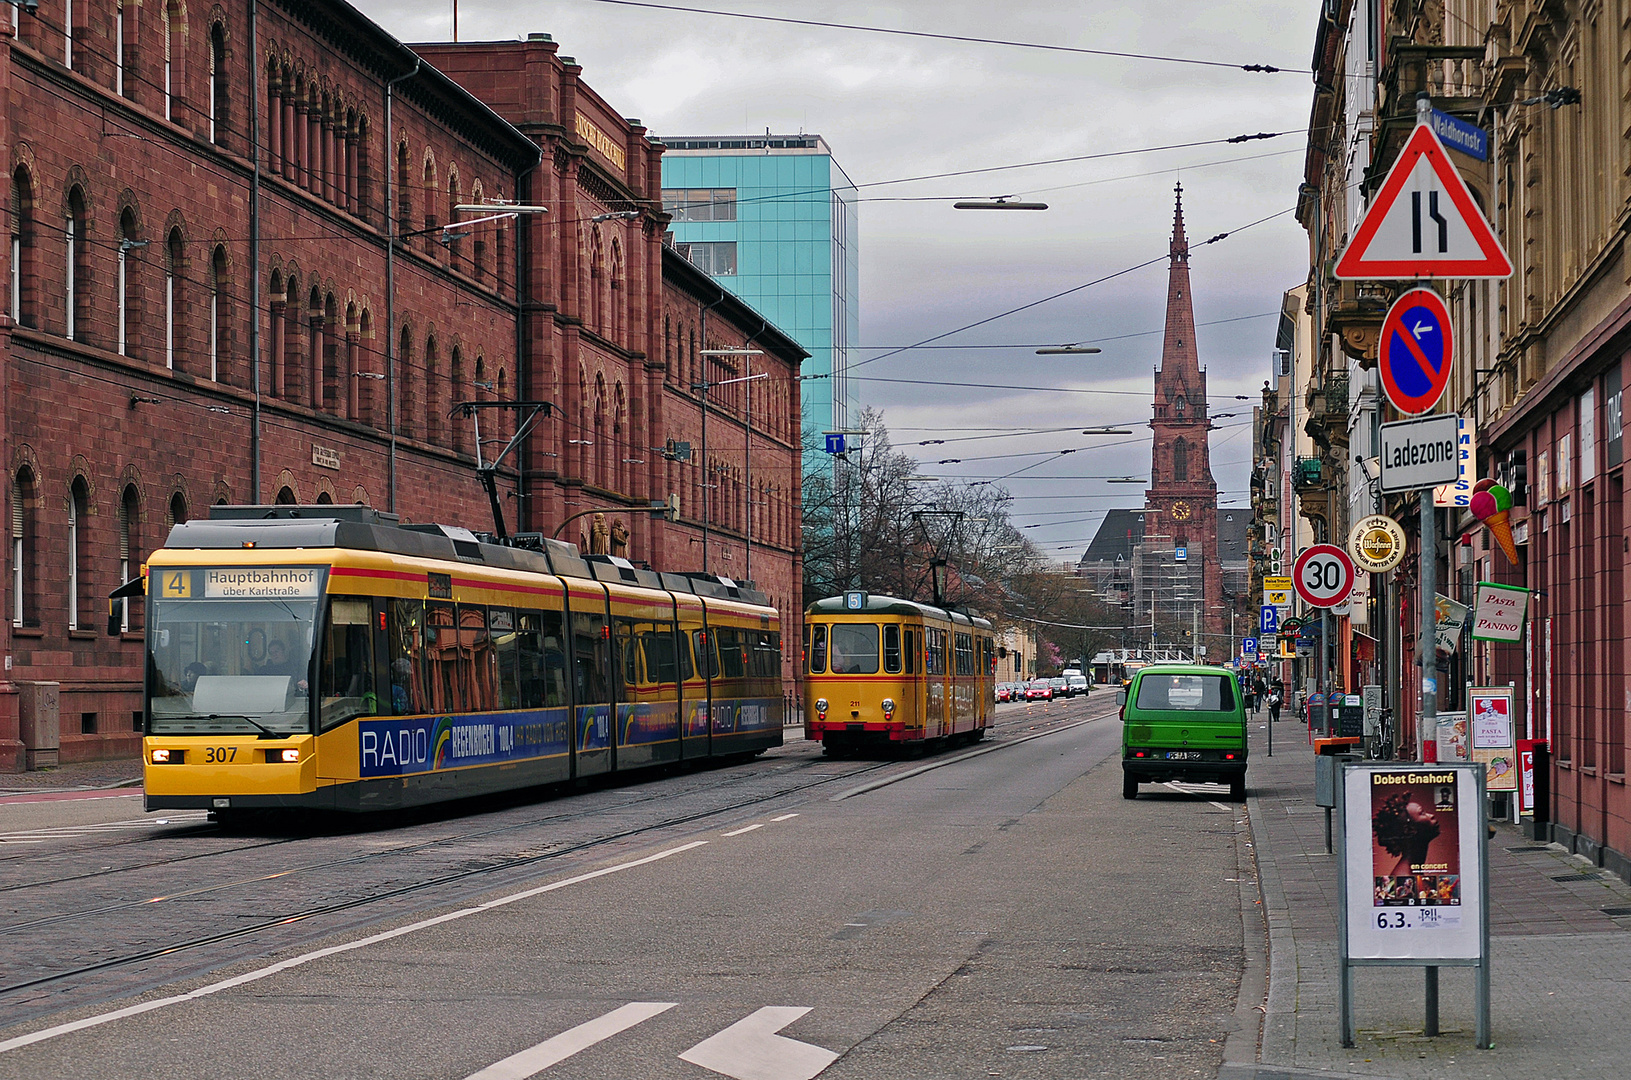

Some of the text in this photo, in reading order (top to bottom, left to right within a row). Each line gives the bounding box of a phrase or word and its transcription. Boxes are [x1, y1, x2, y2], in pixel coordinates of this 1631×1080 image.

[1433, 113, 1483, 153] Waldhornstr.
[829, 437, 840, 451] T
[1384, 438, 1453, 469] Ladezone
[168, 569, 314, 594] 4 Hauptbahnhof
[1306, 560, 1340, 590] 30
[222, 586, 300, 596] über Karlstraße
[1351, 588, 1366, 598] Copy
[849, 593, 859, 608] 5
[1485, 594, 1516, 607] PASTA
[1263, 608, 1274, 630] P
[1477, 619, 1518, 632] PANINO
[1245, 639, 1255, 652] P
[452, 723, 495, 758] REGENBOGEN
[205, 747, 238, 763] 307
[1373, 772, 1454, 785] Dobet Gnahoré
[1420, 862, 1449, 870] concert
[1376, 911, 1412, 929] 6.3.
